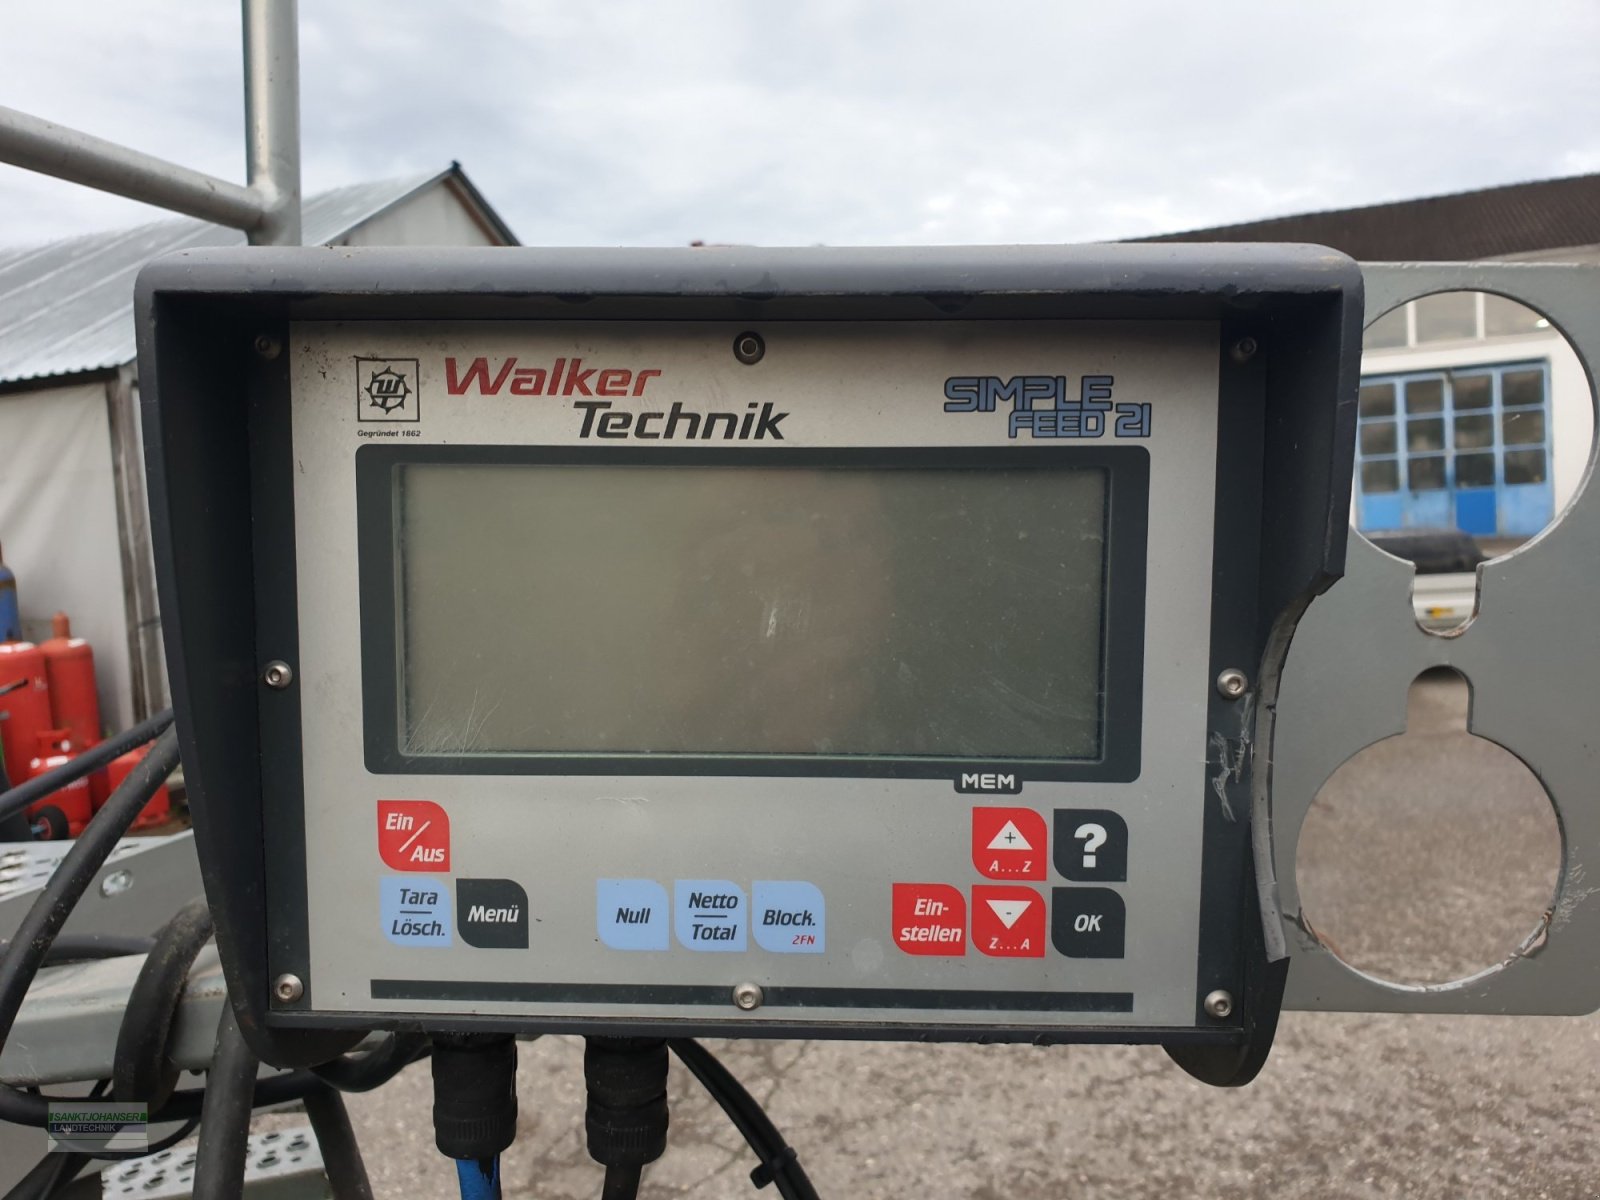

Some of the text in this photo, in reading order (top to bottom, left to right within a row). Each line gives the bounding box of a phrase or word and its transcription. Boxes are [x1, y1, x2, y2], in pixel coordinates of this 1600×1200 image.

[445, 357, 662, 397] Walker
[944, 376, 1114, 412] SIMPLE
[573, 400, 790, 440] Technik
[1008, 403, 1152, 438] FEED 21
[357, 429, 399, 438] Gegründet
[961, 773, 1015, 789] MEM
[385, 813, 414, 831] Ein
[410, 845, 445, 863] Aus
[1074, 823, 1107, 868] ?
[399, 888, 438, 905] Tara
[688, 892, 738, 909] Netto
[467, 904, 519, 923] Menü
[615, 907, 651, 924] Null
[914, 898, 949, 917] Ein-
[391, 918, 446, 936] Lösch.
[762, 909, 816, 927] Block.
[1073, 914, 1103, 932] OK
[691, 924, 737, 941] Total
[792, 934, 816, 945] 2FN
[899, 924, 962, 942] stellen
